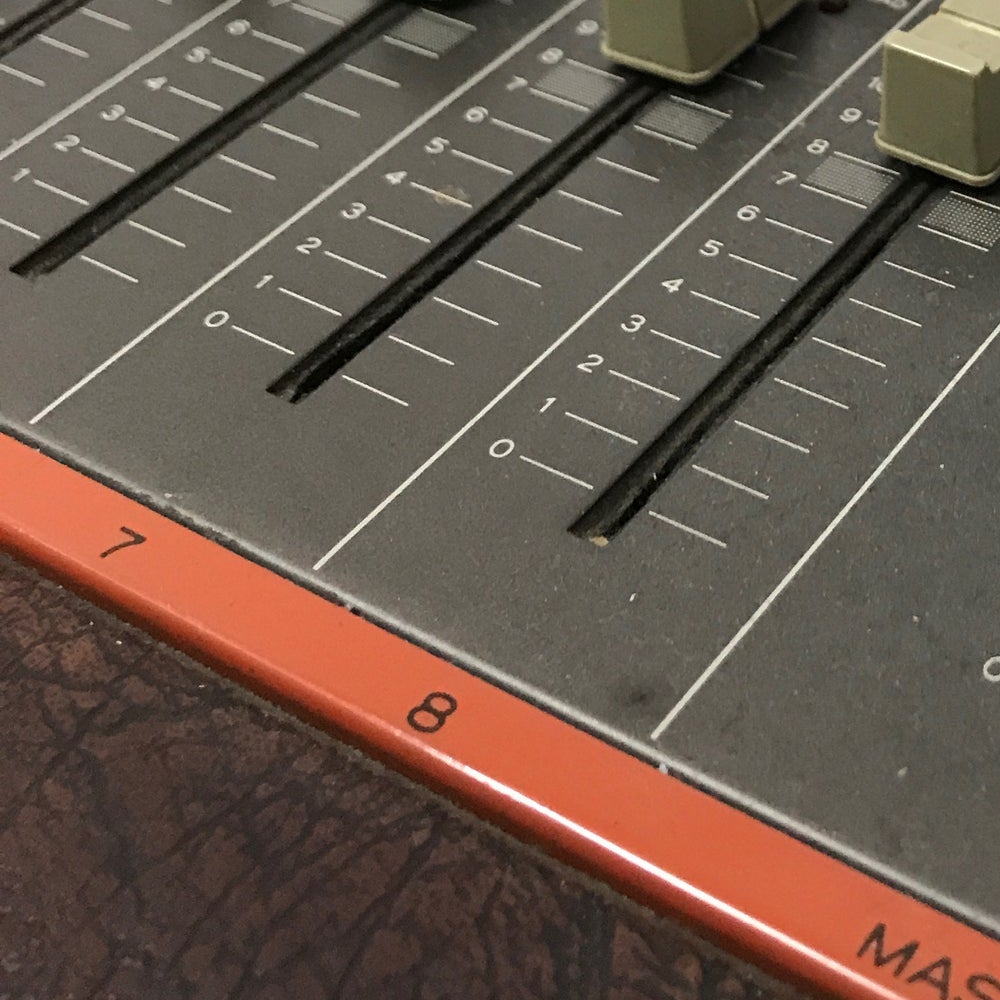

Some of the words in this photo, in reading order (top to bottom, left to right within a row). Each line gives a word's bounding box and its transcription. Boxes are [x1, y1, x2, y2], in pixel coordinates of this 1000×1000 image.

[101, 103, 126, 121] 3
[464, 105, 489, 123] 6
[839, 107, 863, 123] 9
[53, 133, 81, 152] 2
[424, 136, 450, 154] 5
[806, 138, 830, 154] 8
[12, 167, 31, 182] 1
[384, 170, 408, 185] 4
[776, 170, 797, 185] 7
[340, 202, 367, 220] 3
[737, 204, 761, 222] 6
[295, 236, 323, 255] 2
[700, 239, 724, 256] 5
[254, 274, 274, 289] 1
[661, 278, 684, 293] 4
[203, 310, 230, 328] 0
[620, 314, 646, 333] 3
[577, 354, 604, 373] 2
[539, 397, 557, 413] 1
[488, 438, 515, 458] 0
[101, 526, 147, 558] 7
[407, 691, 458, 733] 8
